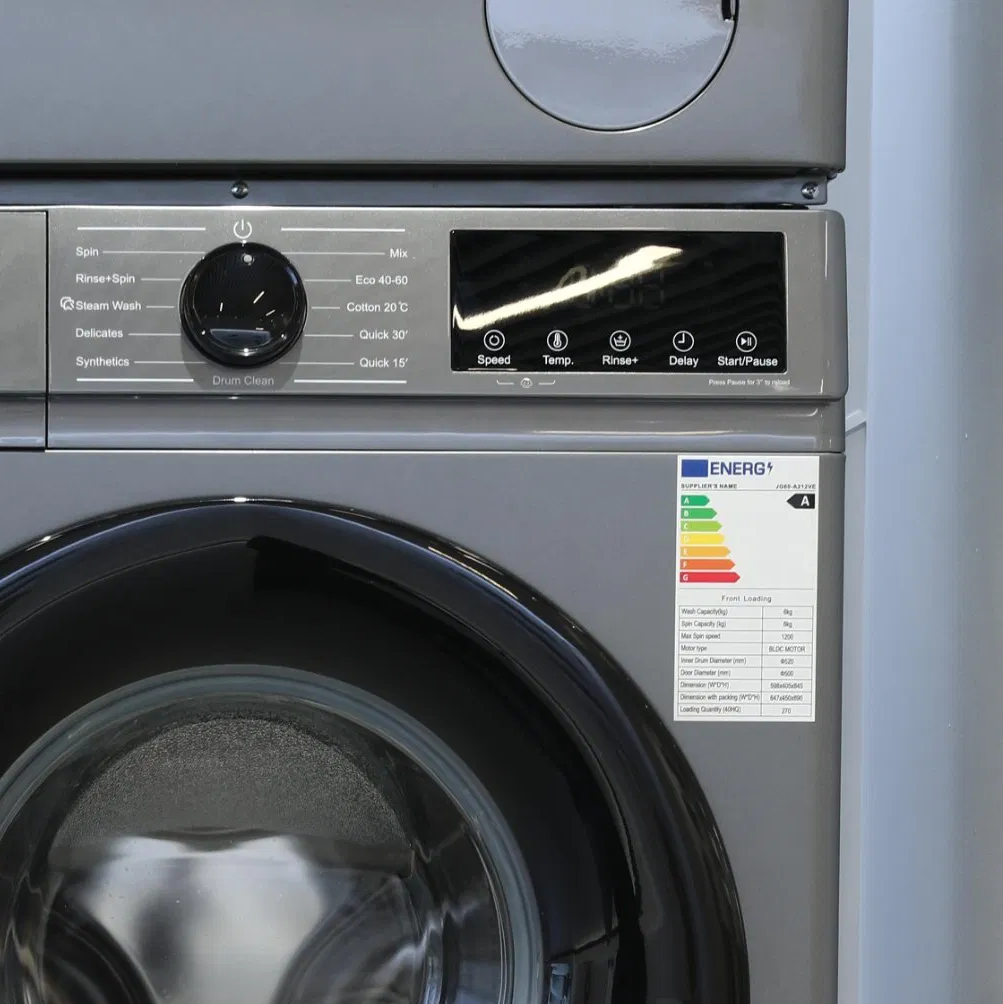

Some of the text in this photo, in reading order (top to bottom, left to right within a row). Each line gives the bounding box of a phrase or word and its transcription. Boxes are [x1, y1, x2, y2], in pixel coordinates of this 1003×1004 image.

[76, 247, 99, 258] Spin
[389, 248, 408, 258] Mix
[76, 273, 136, 285] Rinse+Spin
[355, 275, 408, 285] Eco 40-60
[75, 300, 142, 311] Steam Wash
[346, 302, 380, 312] Cotton
[75, 328, 124, 338] Delicates
[359, 329, 389, 340] Quick
[76, 356, 130, 368] Synthetics
[359, 357, 389, 368] Quick
[477, 354, 511, 366] Speed
[542, 355, 574, 367] Temp.
[602, 355, 639, 366] Rinse+
[669, 355, 699, 367] Delay
[717, 355, 778, 367] Start/Pause
[212, 375, 275, 387] Drum Clean
[710, 462, 766, 476] ENERG
[800, 496, 810, 506] A
[743, 595, 772, 603] Loading
